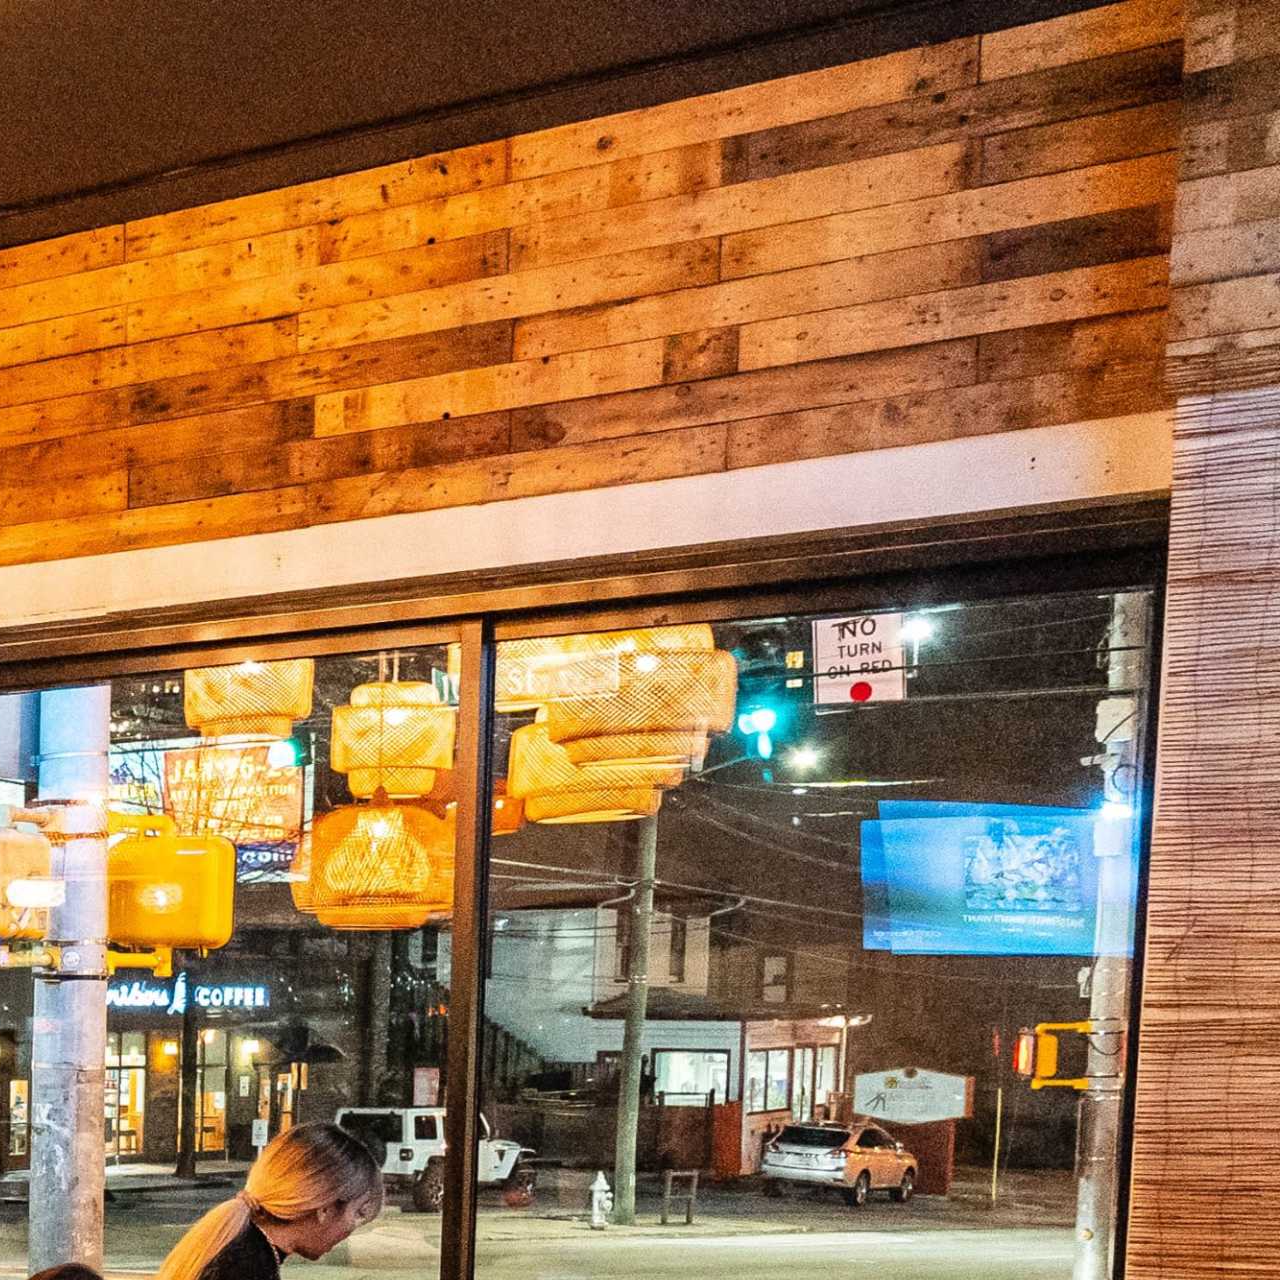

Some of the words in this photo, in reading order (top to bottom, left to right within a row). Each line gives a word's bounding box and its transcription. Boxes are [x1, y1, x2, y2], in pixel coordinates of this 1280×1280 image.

[838, 618, 876, 640] NO
[838, 641, 882, 659] TURN
[828, 664, 850, 679] ON
[860, 659, 892, 675] RED
[197, 986, 267, 1007] COFFEE
